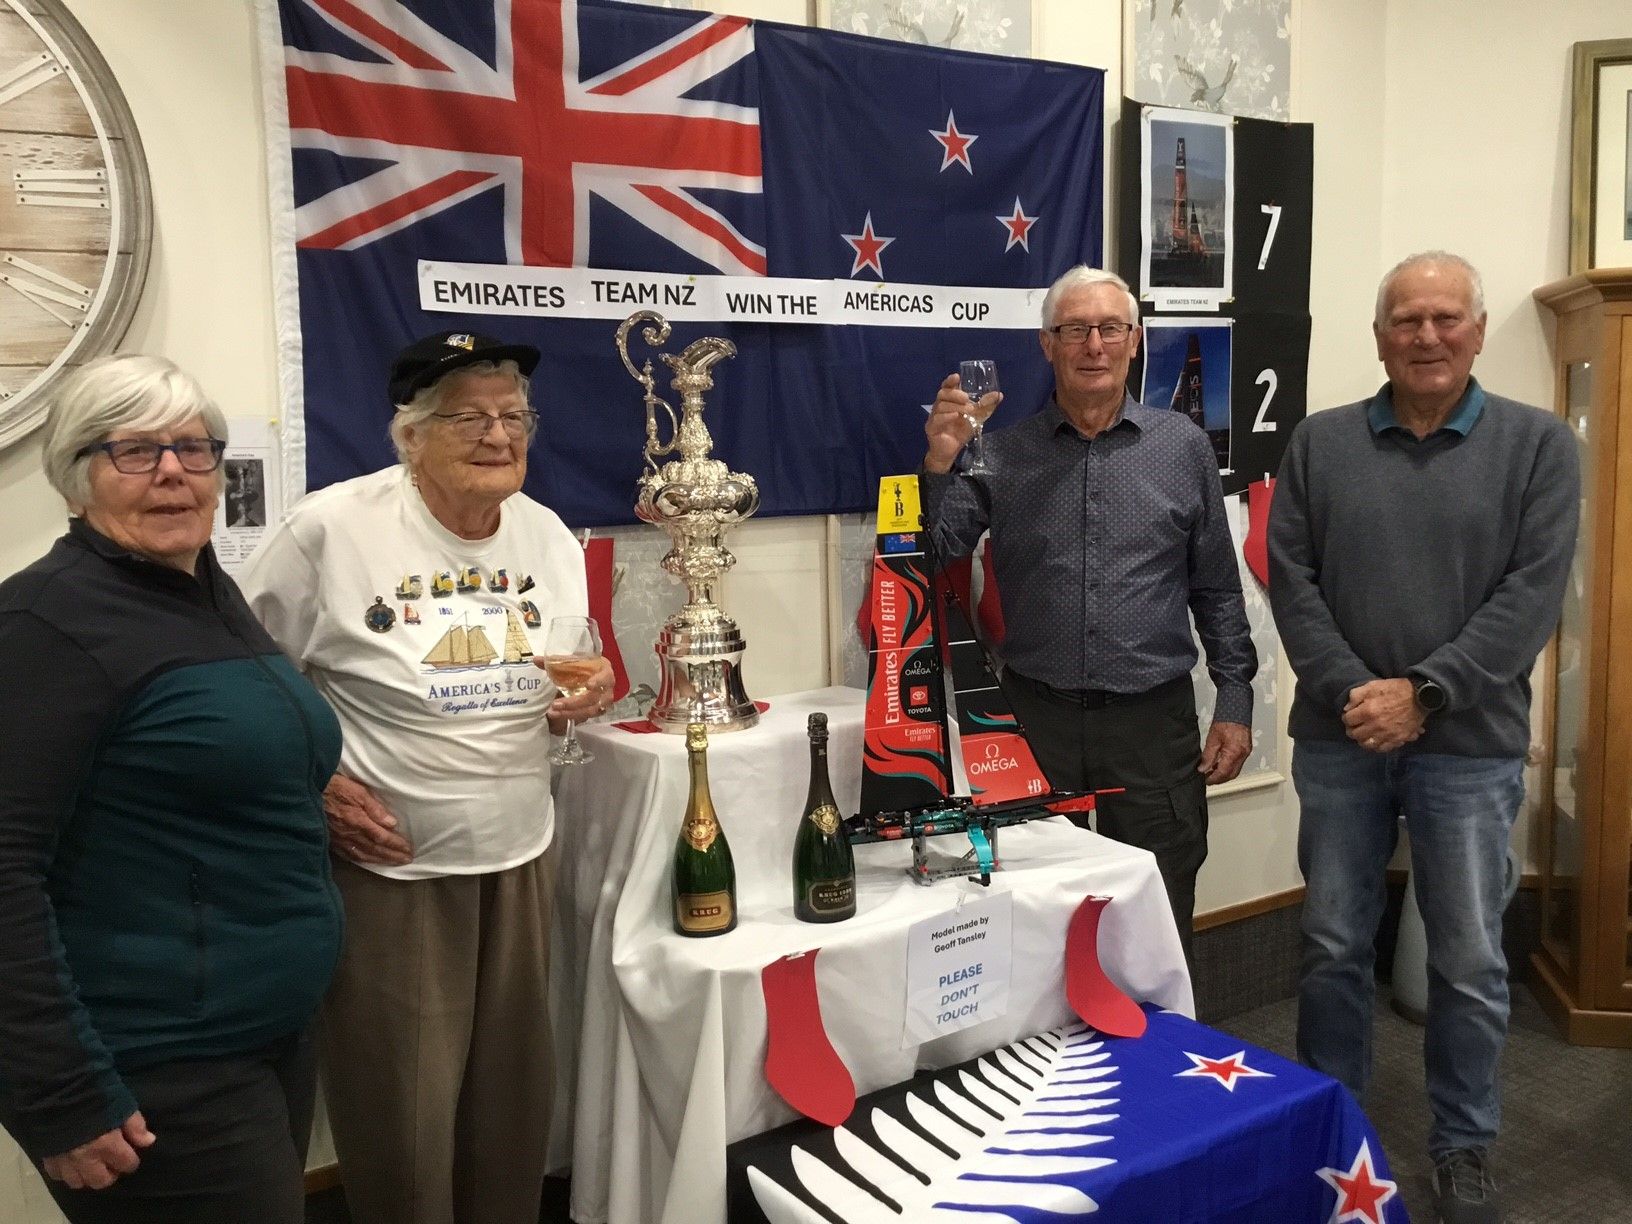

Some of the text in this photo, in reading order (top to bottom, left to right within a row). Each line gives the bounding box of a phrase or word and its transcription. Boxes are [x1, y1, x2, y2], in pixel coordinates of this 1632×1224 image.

[1257, 204, 1282, 271] 7
[434, 280, 990, 322] EMIRATES TEAM NZ WIN THE AMERICAS CUP
[1166, 298, 1190, 306] EMIRATES
[1251, 367, 1278, 433] 2
[481, 606, 503, 615] 2000
[880, 580, 900, 725] Emirates FLY BETTER
[904, 667, 932, 677] OMEGA
[427, 677, 542, 699] AMERICA'S CUP
[441, 697, 529, 715] Regatta of Excellence
[907, 706, 932, 715] TOYOTA
[904, 727, 936, 737] Emirates
[969, 756, 1019, 776] OMEGA
[692, 907, 719, 916] KRUG
[931, 915, 990, 940] Model made by
[934, 931, 987, 954] Geoff Tansley
[938, 962, 983, 988] PLEASE
[940, 983, 980, 1007] DON'T
[936, 1002, 979, 1025] TOUCH
